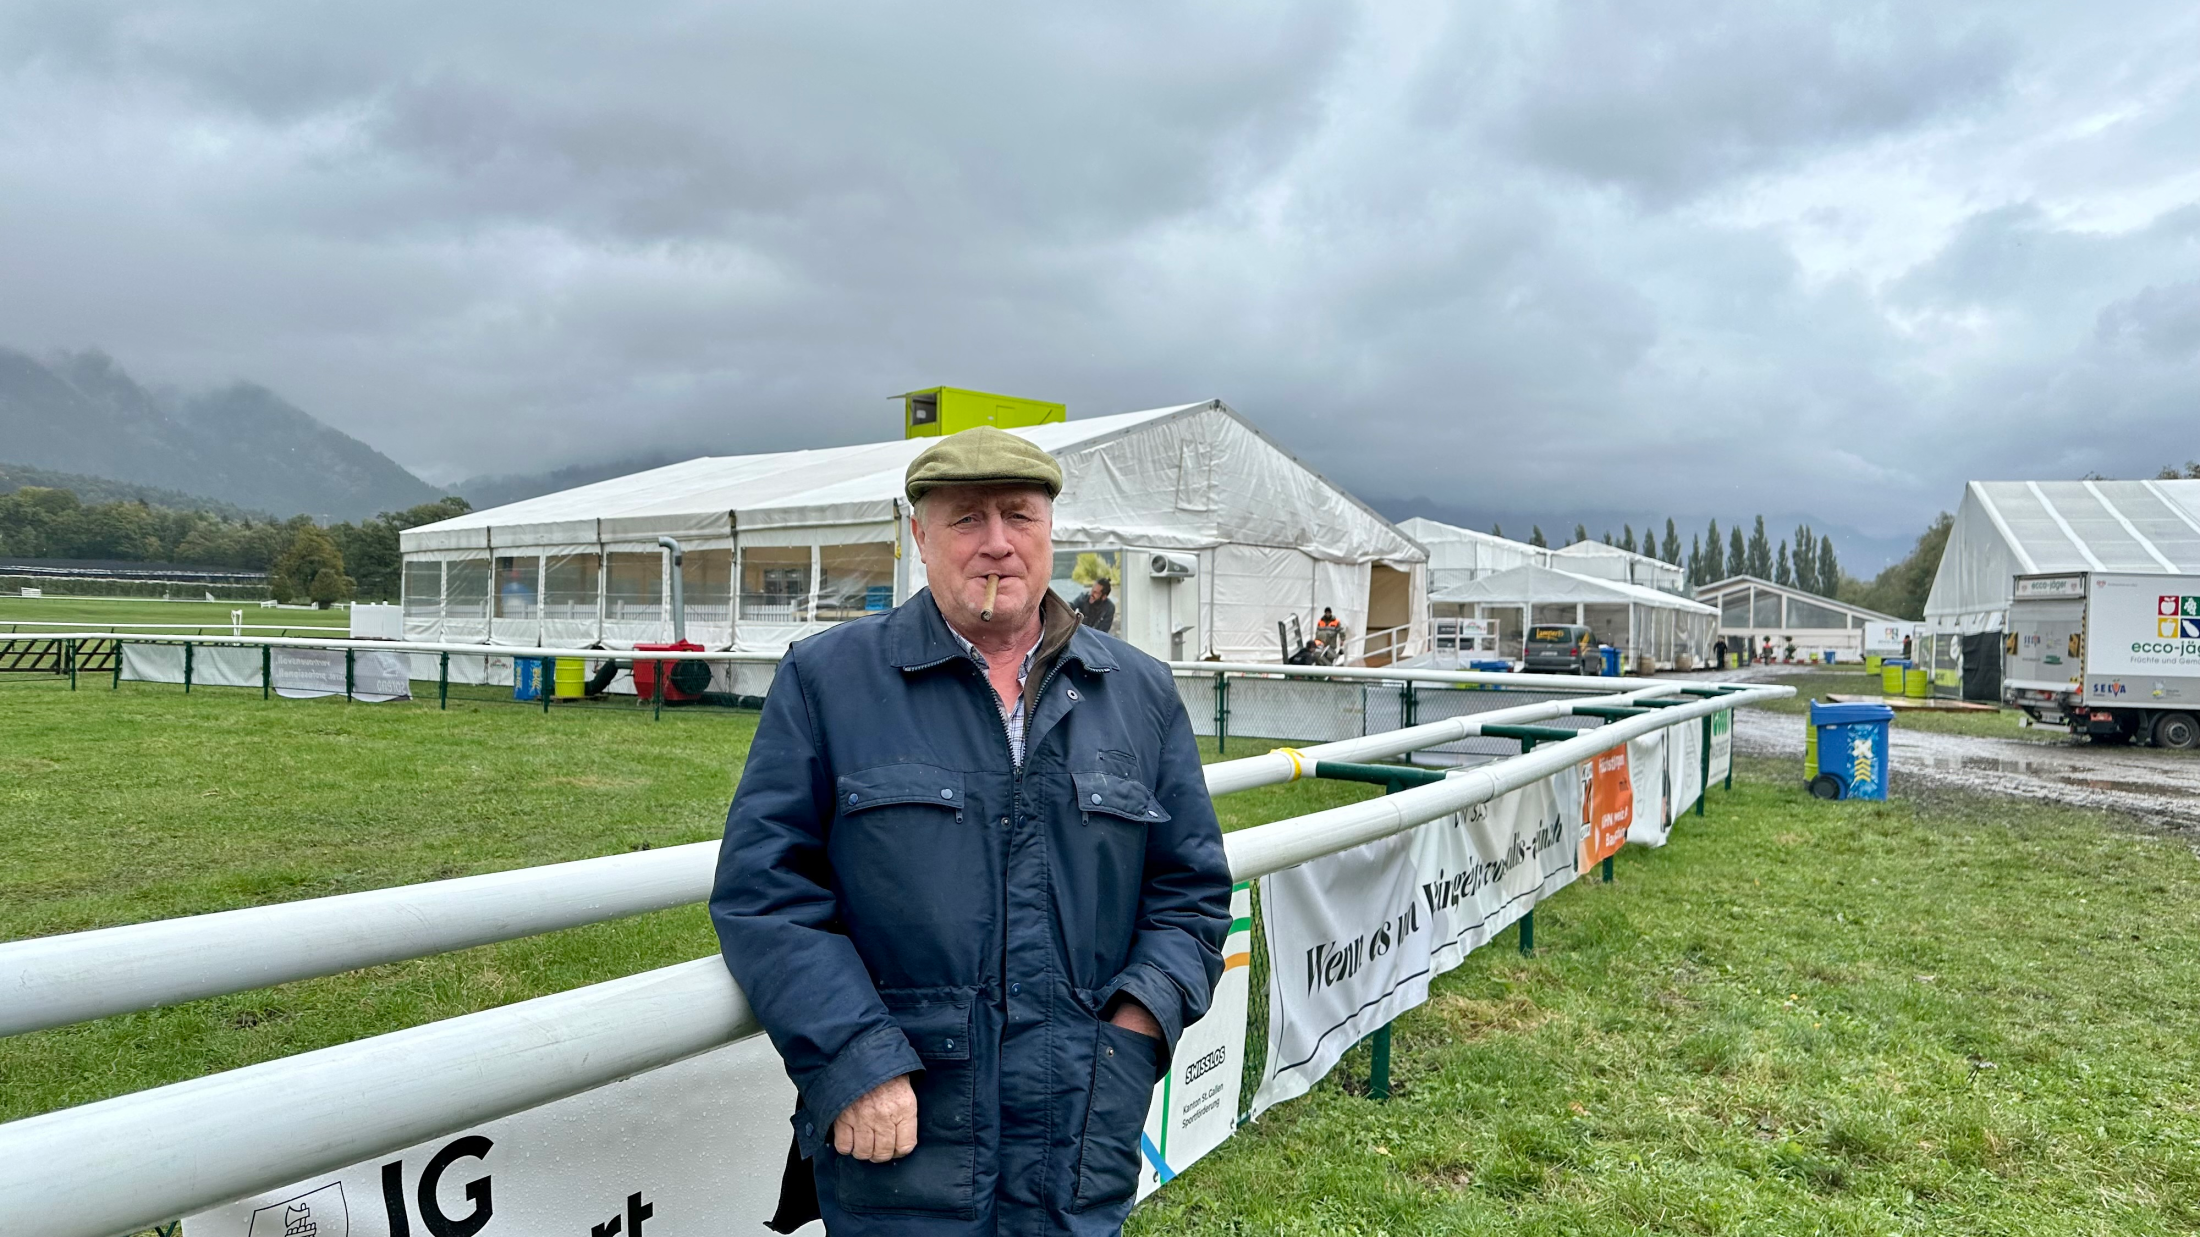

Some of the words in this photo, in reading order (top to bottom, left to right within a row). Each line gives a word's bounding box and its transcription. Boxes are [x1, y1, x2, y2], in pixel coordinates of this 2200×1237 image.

[2131, 640, 2200, 657] ecco-jä
[2093, 681, 2126, 698] SELVA
[1306, 934, 1364, 999] Wenn
[1369, 920, 1392, 962] es
[1185, 1046, 1226, 1085] SWISSLOS
[1182, 1098, 1220, 1129] Sportförderung
[1183, 1091, 1201, 1116] Kanton
[1201, 1088, 1209, 1104] St.
[1208, 1082, 1224, 1102] Gallen
